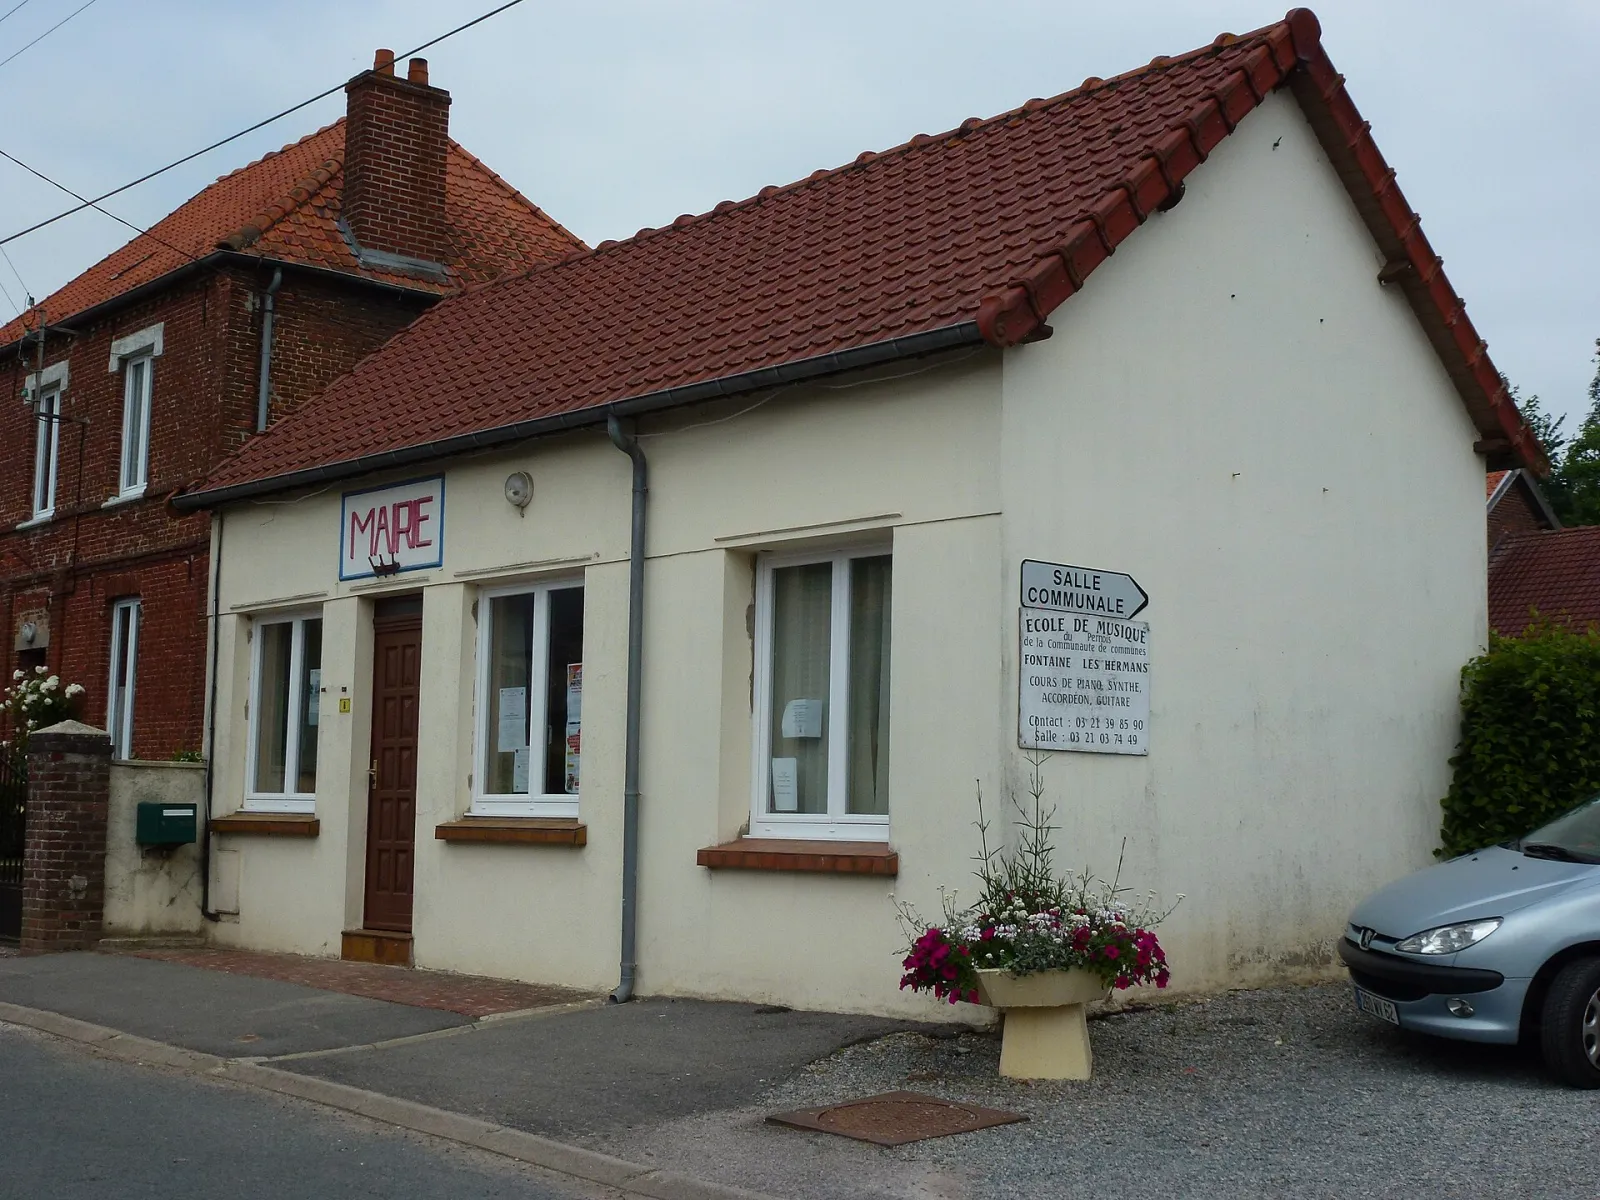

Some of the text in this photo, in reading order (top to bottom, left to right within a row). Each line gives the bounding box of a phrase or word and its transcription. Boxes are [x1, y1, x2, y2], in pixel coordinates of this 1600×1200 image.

[1053, 569, 1101, 591] SALLE
[1028, 586, 1124, 614] COMMUNALE
[1026, 618, 1147, 645] ECOLE DE MUSIQUE
[1063, 631, 1073, 642] du
[1023, 636, 1034, 647] de
[1036, 637, 1043, 648] la
[1098, 642, 1107, 653] de
[1110, 646, 1146, 656] communes
[1024, 654, 1148, 673] FONTAINE LES HERMANS
[1029, 675, 1057, 688] COURS
[1062, 677, 1072, 689] DE
[1096, 695, 1131, 708] GUITARE
[1029, 714, 1063, 728] Contact
[1075, 716, 1086, 729] 03
[1090, 717, 1100, 729] 21
[1105, 718, 1115, 730] 39
[1119, 718, 1129, 730] 85
[1133, 719, 1144, 731] 90
[1035, 730, 1058, 743] Salle
[1069, 731, 1080, 743] 03
[1085, 732, 1095, 744] 21
[1100, 732, 1110, 744] 03
[1127, 734, 1138, 745] 49
